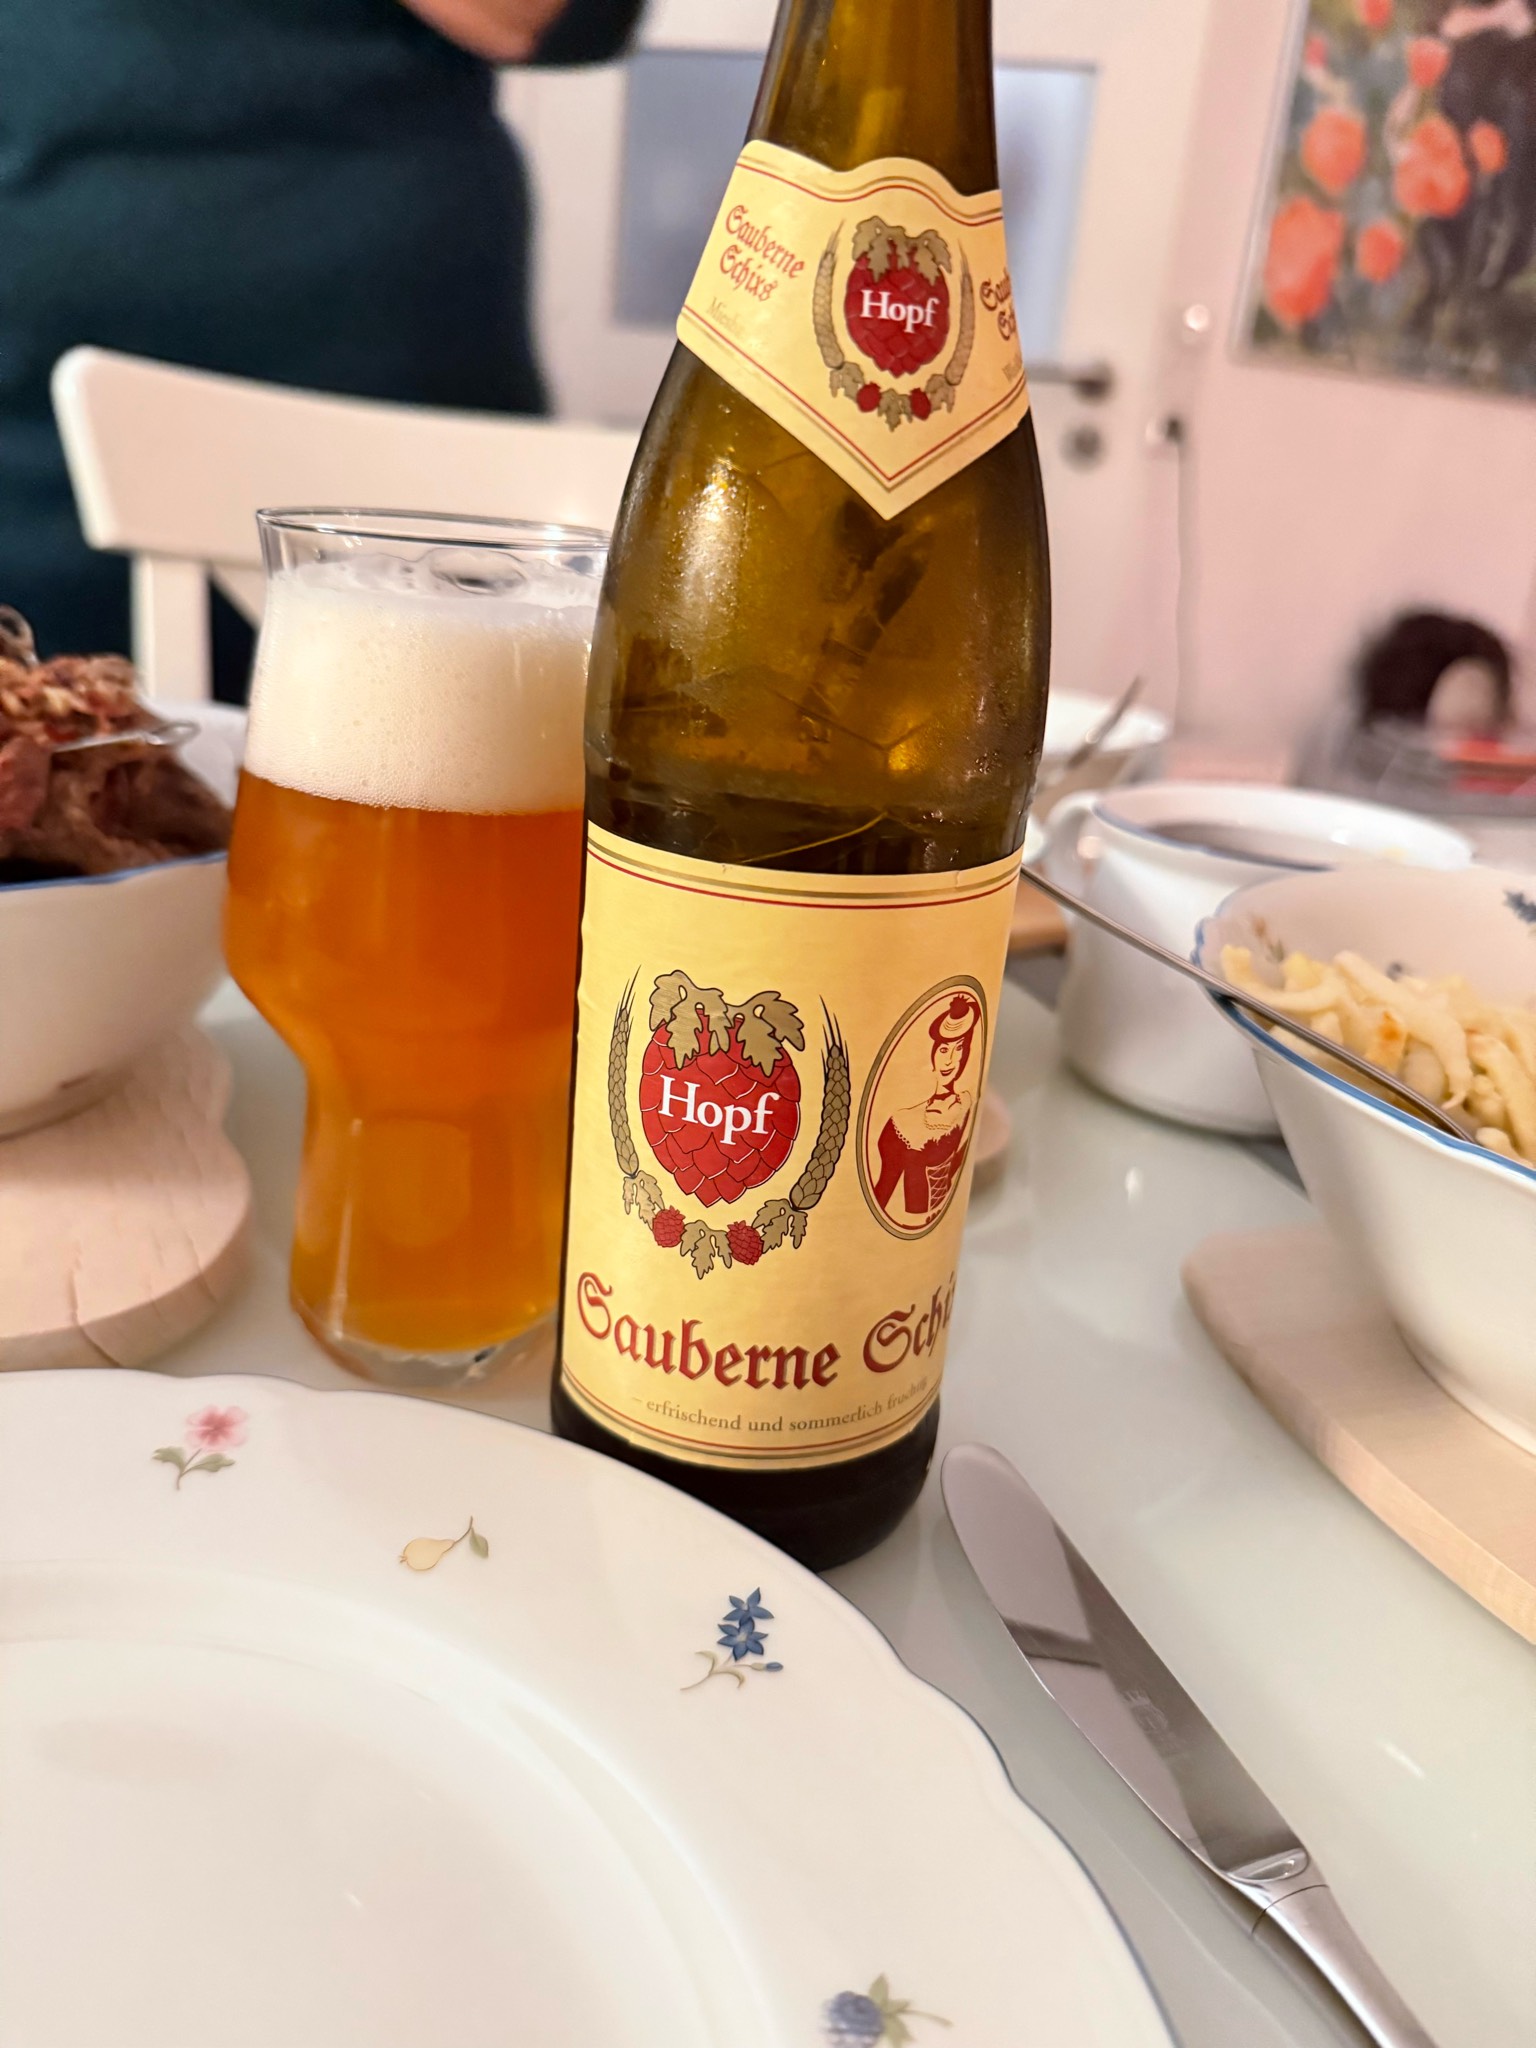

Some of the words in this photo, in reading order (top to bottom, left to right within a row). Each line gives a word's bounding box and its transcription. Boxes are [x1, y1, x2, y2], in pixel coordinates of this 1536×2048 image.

[725, 204, 805, 279] Sauberne
[860, 289, 940, 334] Hopf
[657, 1074, 779, 1145] Hopf
[577, 1271, 841, 1390] Sauberne
[863, 1270, 956, 1374] Schi
[646, 1399, 742, 1431] erfrischend
[748, 1415, 783, 1432] und
[788, 1400, 883, 1432] sommerlich
